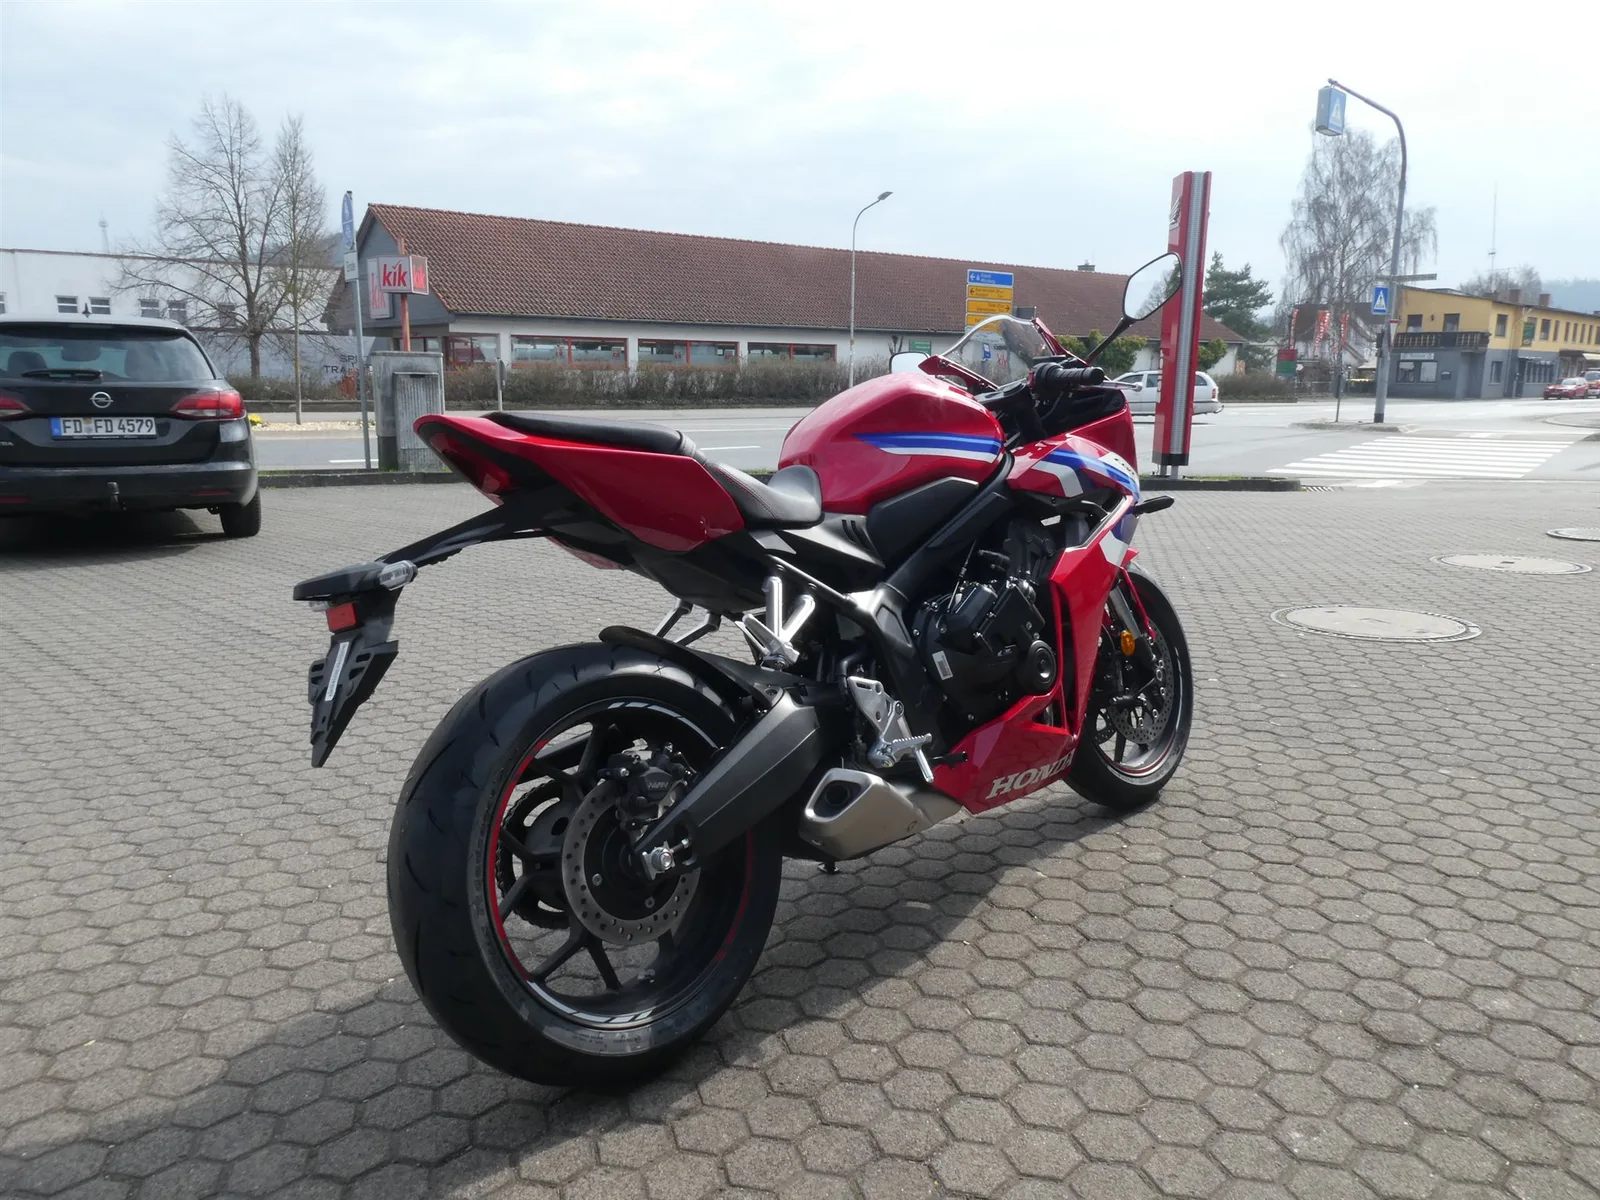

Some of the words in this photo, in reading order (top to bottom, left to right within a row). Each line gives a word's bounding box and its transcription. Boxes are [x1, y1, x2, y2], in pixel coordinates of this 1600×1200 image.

[62, 419, 83, 434] FD
[93, 419, 114, 433] FD
[118, 419, 154, 433] 4579
[985, 748, 1076, 800] HONDA
